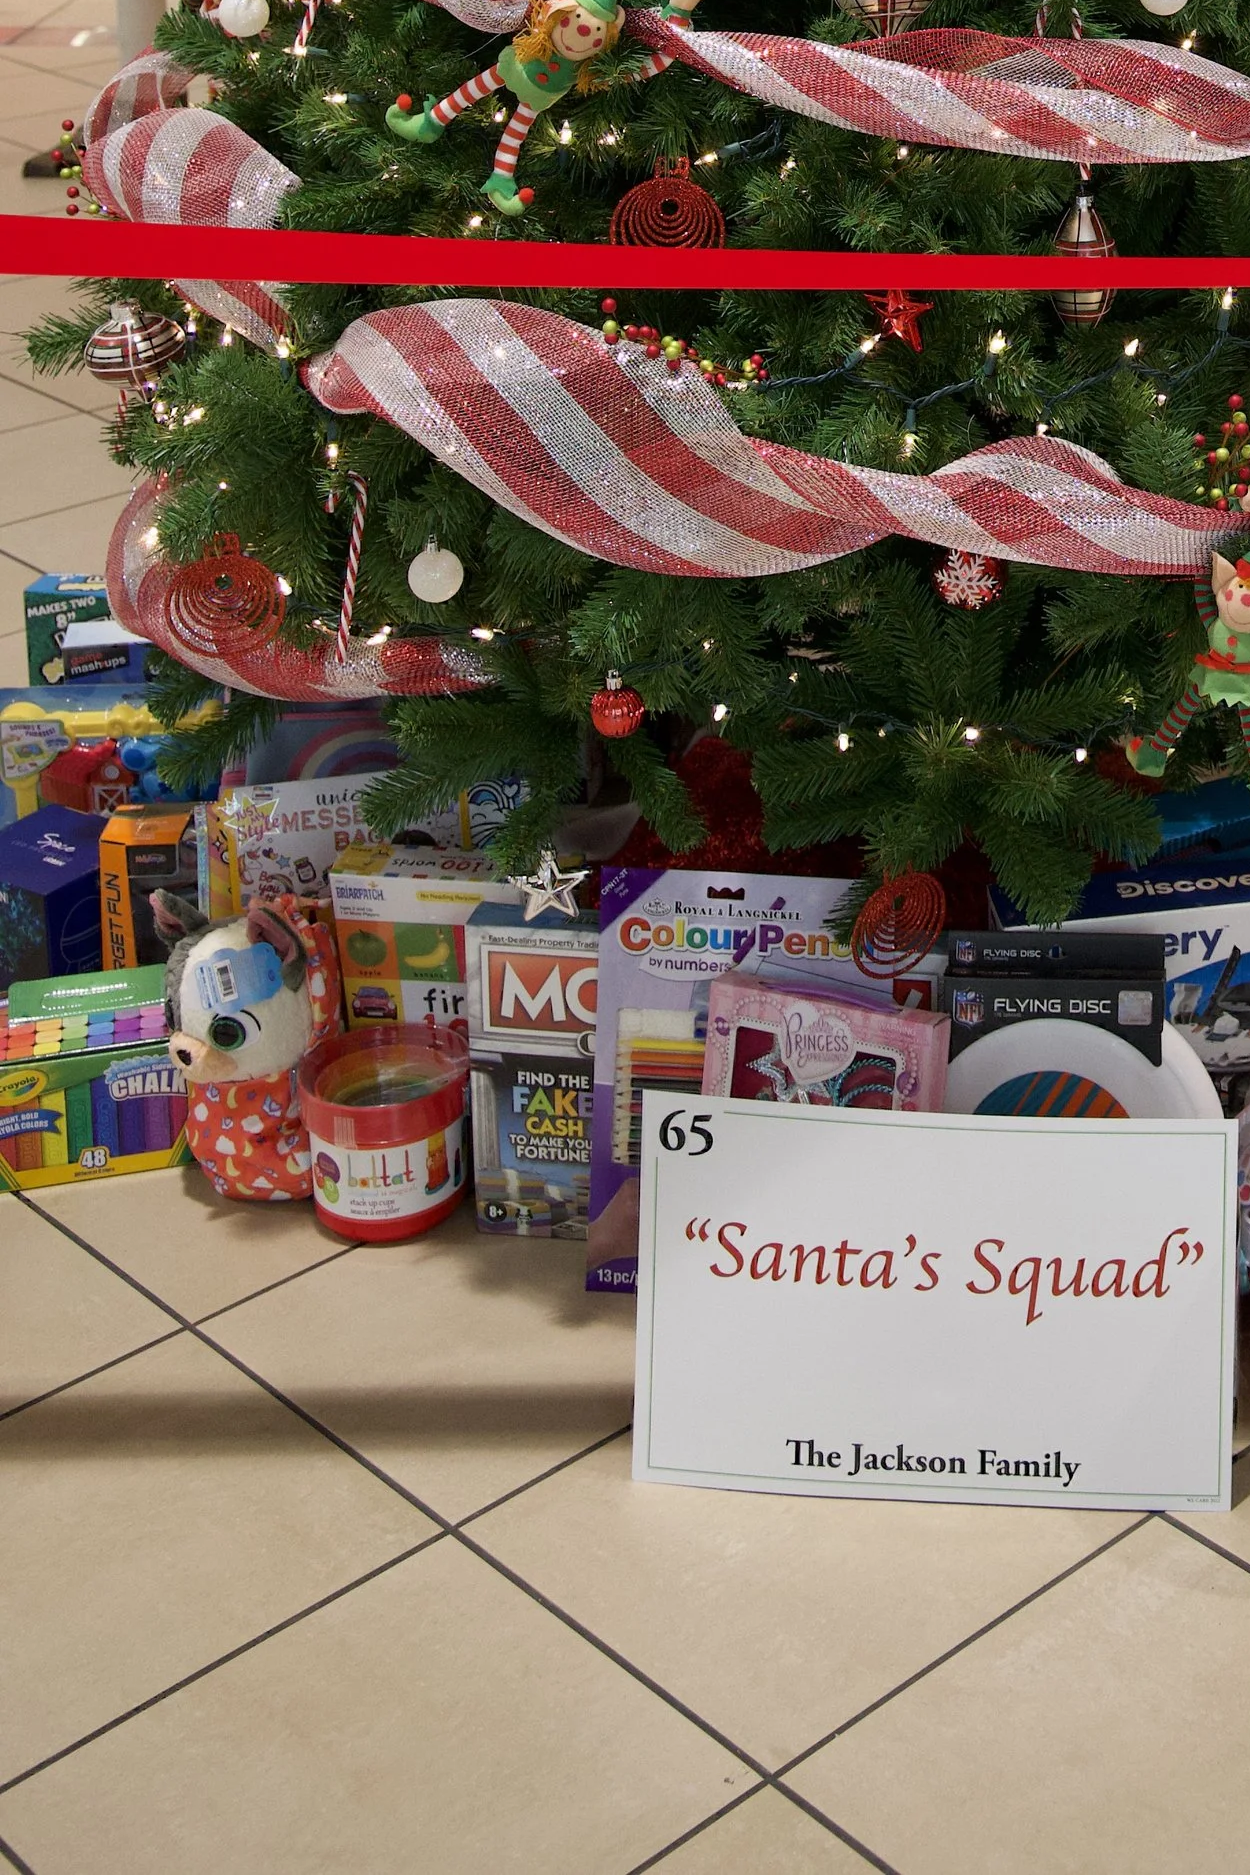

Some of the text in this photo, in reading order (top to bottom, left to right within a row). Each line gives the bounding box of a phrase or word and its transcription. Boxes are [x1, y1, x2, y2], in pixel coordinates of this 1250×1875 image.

[27, 596, 97, 619] MAKES TWO
[235, 804, 259, 822] JUST
[236, 816, 281, 842] Style
[392, 857, 437, 869] words
[441, 859, 482, 872] 100
[104, 872, 123, 916] FUN
[335, 882, 385, 901] BRIARPATCH
[674, 901, 713, 916] ROYAL
[728, 903, 801, 921] LANGNICKEL
[488, 934, 575, 949] Fast-Dealing Property
[620, 917, 748, 952] Colour
[1164, 927, 1224, 961] ery
[983, 949, 1017, 957] FLYING
[1020, 950, 1041, 958] DISC
[650, 956, 731, 973] by numbers
[423, 988, 464, 1015] fir
[994, 998, 1061, 1014] FLYING
[1069, 999, 1111, 1014] DISC
[783, 1012, 849, 1058] PRINCESS
[112, 1070, 187, 1099] CHALK
[517, 1071, 590, 1089] FIND THE
[512, 1086, 594, 1118] FAKE
[21, 1111, 39, 1123] BOLD
[21, 1120, 49, 1131] COLORS
[526, 1117, 584, 1137] CASH
[509, 1133, 528, 1145] TO
[530, 1135, 564, 1148] MAKE
[659, 1110, 714, 1156] 65
[80, 1148, 107, 1168] 48
[347, 1149, 416, 1188] battat
[488, 1204, 504, 1218] 8+
[686, 1217, 1205, 1326] “Santa’s Squad”
[786, 1439, 1082, 1486] The Jackson Family
